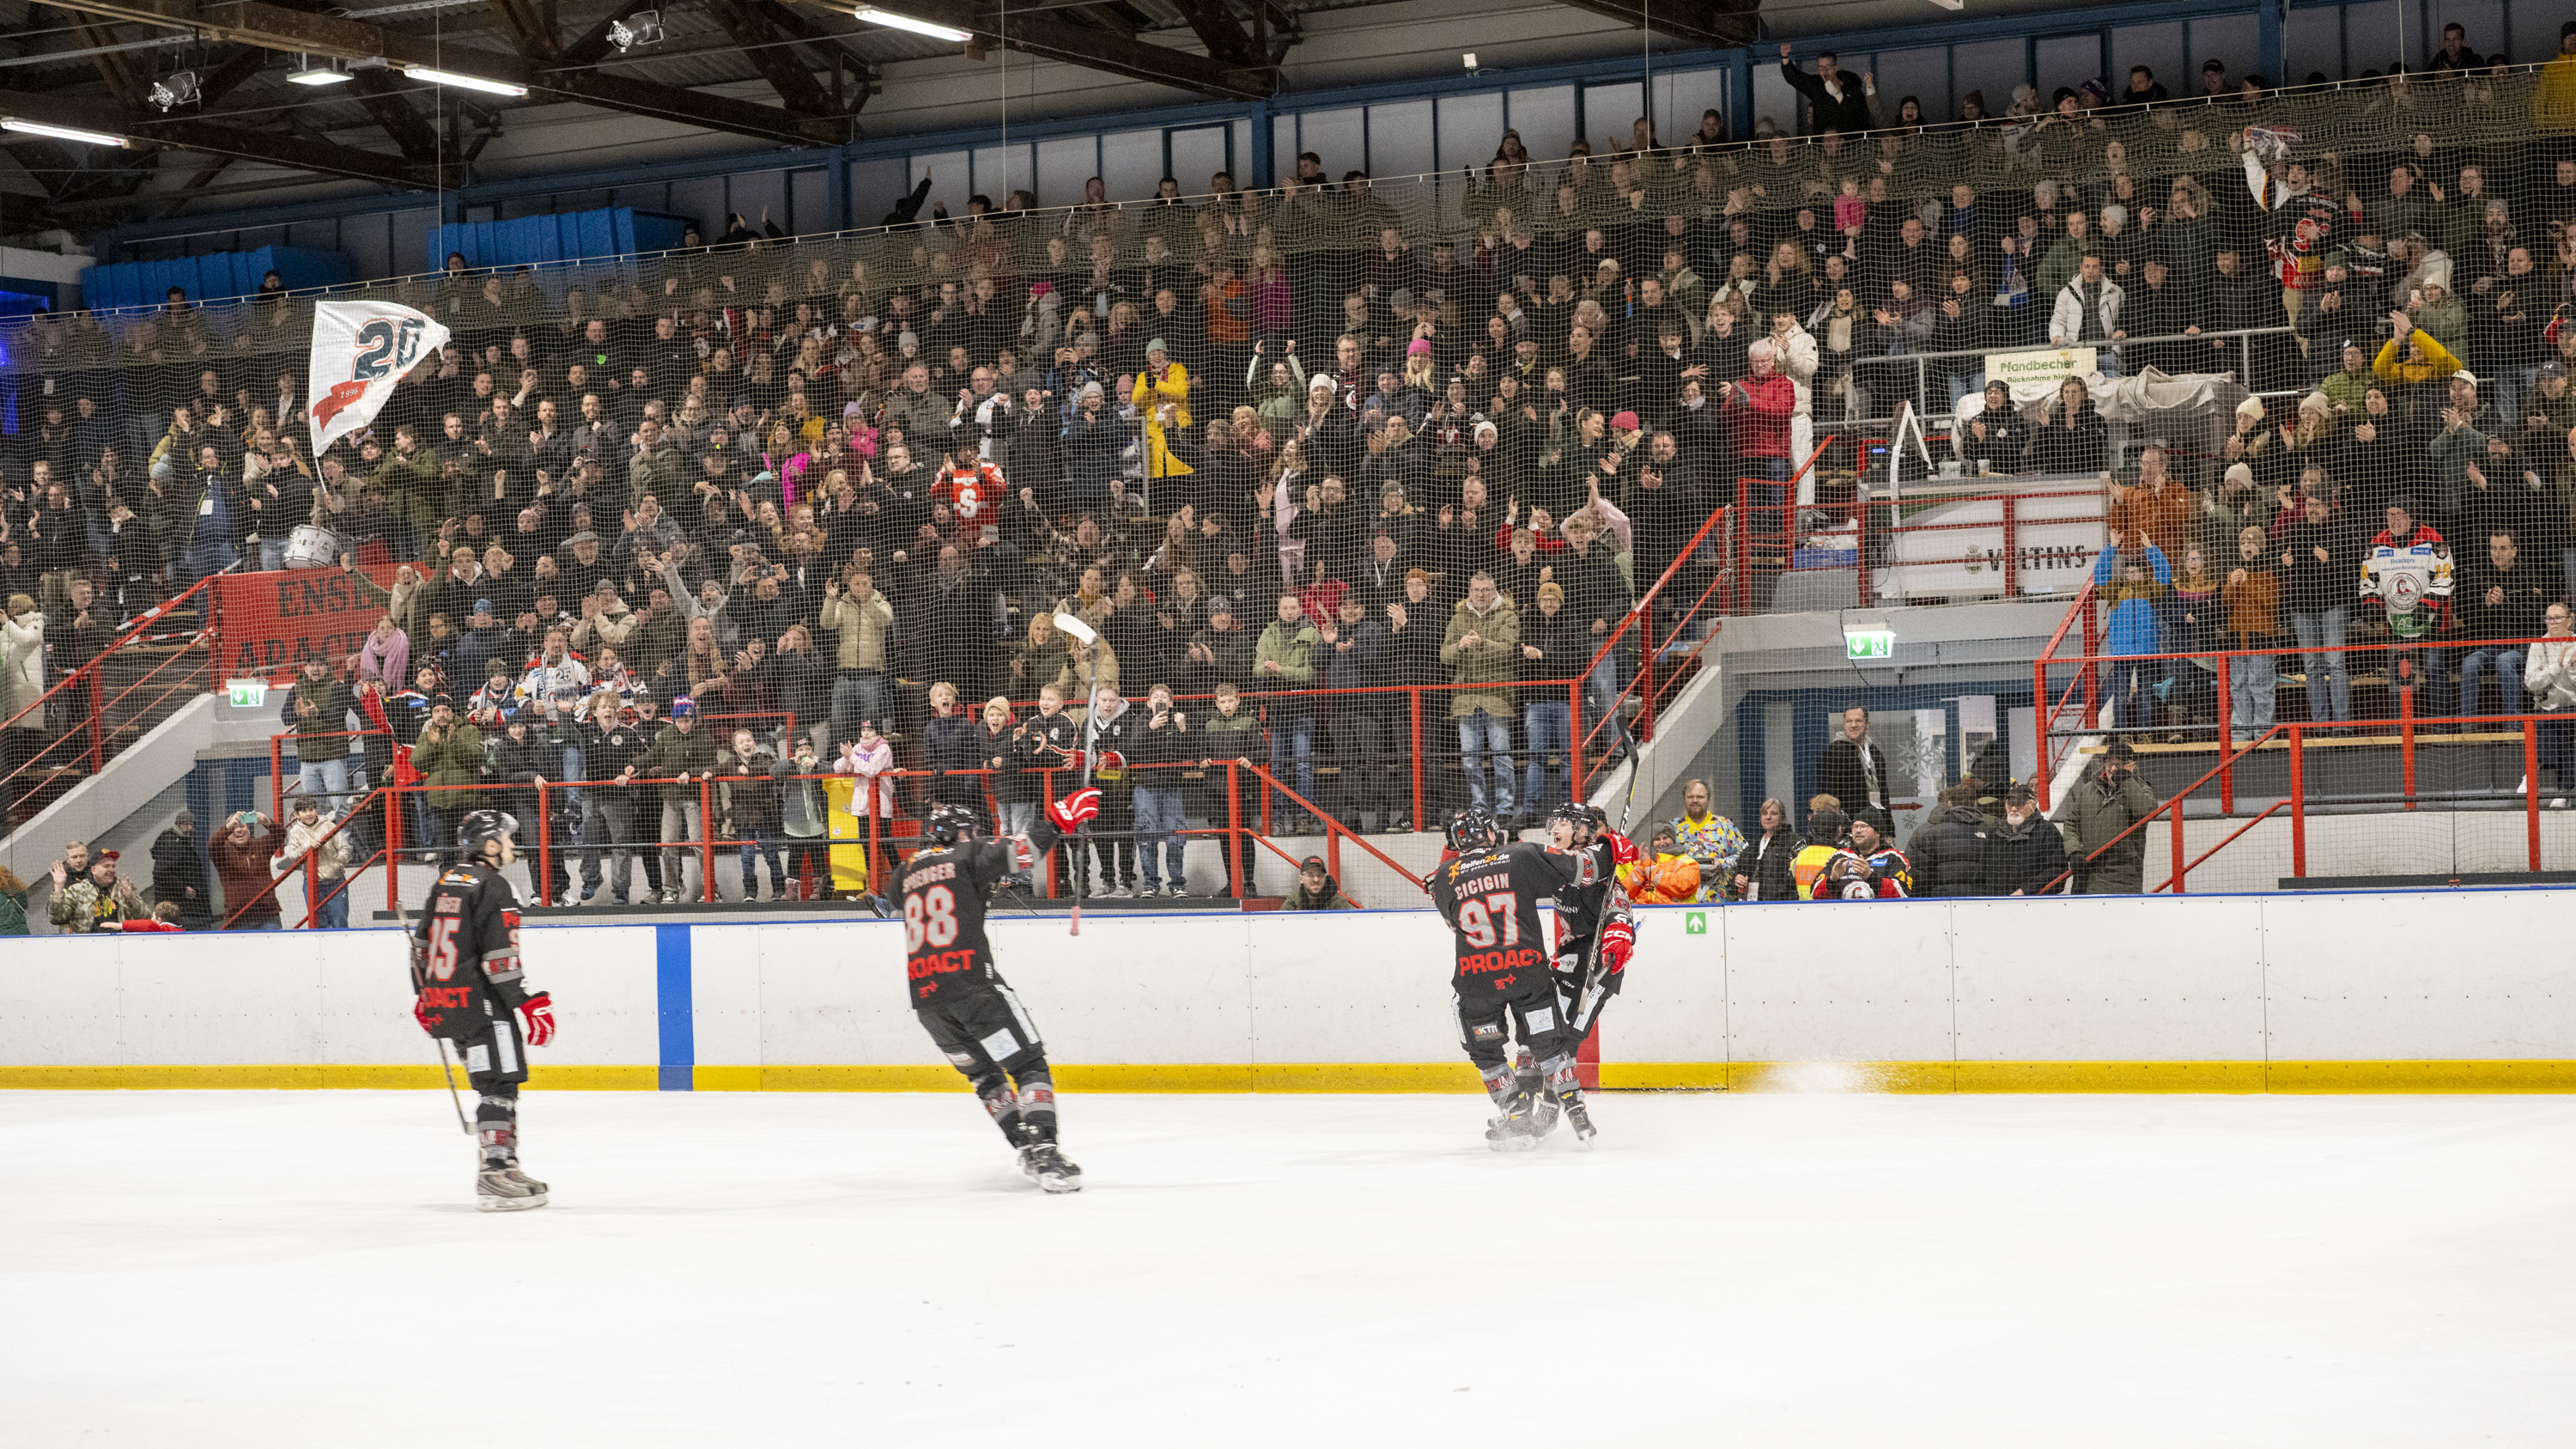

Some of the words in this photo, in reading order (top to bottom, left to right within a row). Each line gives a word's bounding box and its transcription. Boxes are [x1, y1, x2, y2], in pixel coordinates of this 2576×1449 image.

[2000, 359, 2077, 373] Pfandbecher
[339, 387, 359, 399] 1996
[1987, 544, 2087, 572] VLTINS
[556, 670, 572, 681] 25
[1460, 853, 1510, 871] Reifen24.de
[904, 884, 959, 955] 88
[1458, 891, 1519, 949] 97
